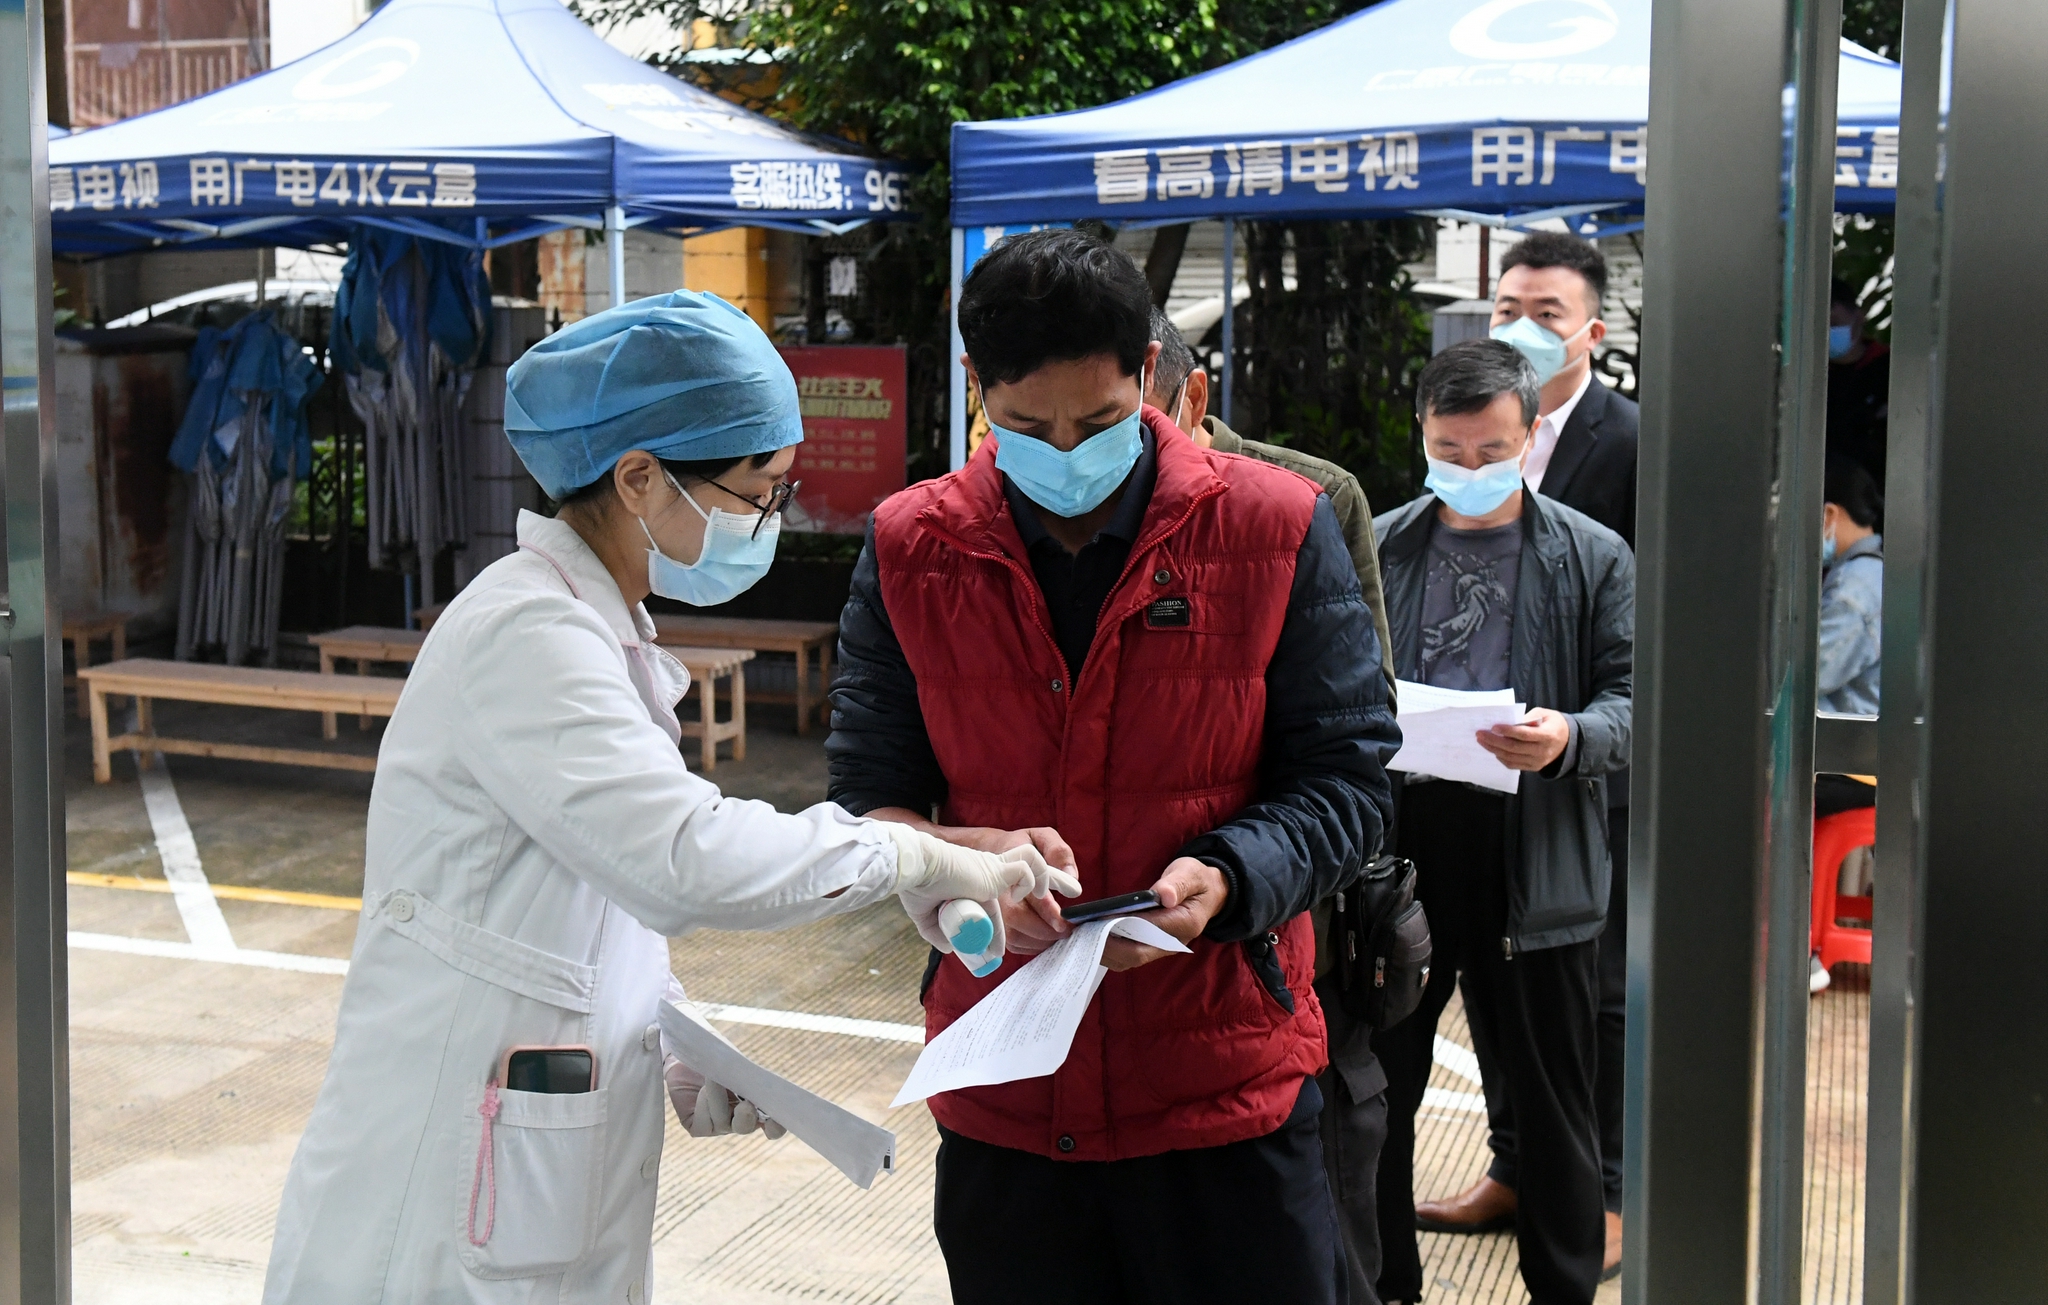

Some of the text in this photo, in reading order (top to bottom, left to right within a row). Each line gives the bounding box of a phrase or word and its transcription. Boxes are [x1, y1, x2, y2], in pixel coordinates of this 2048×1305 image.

[189, 158, 477, 208] 用广电4K云盒
[1093, 130, 1420, 204] 看高清电视
